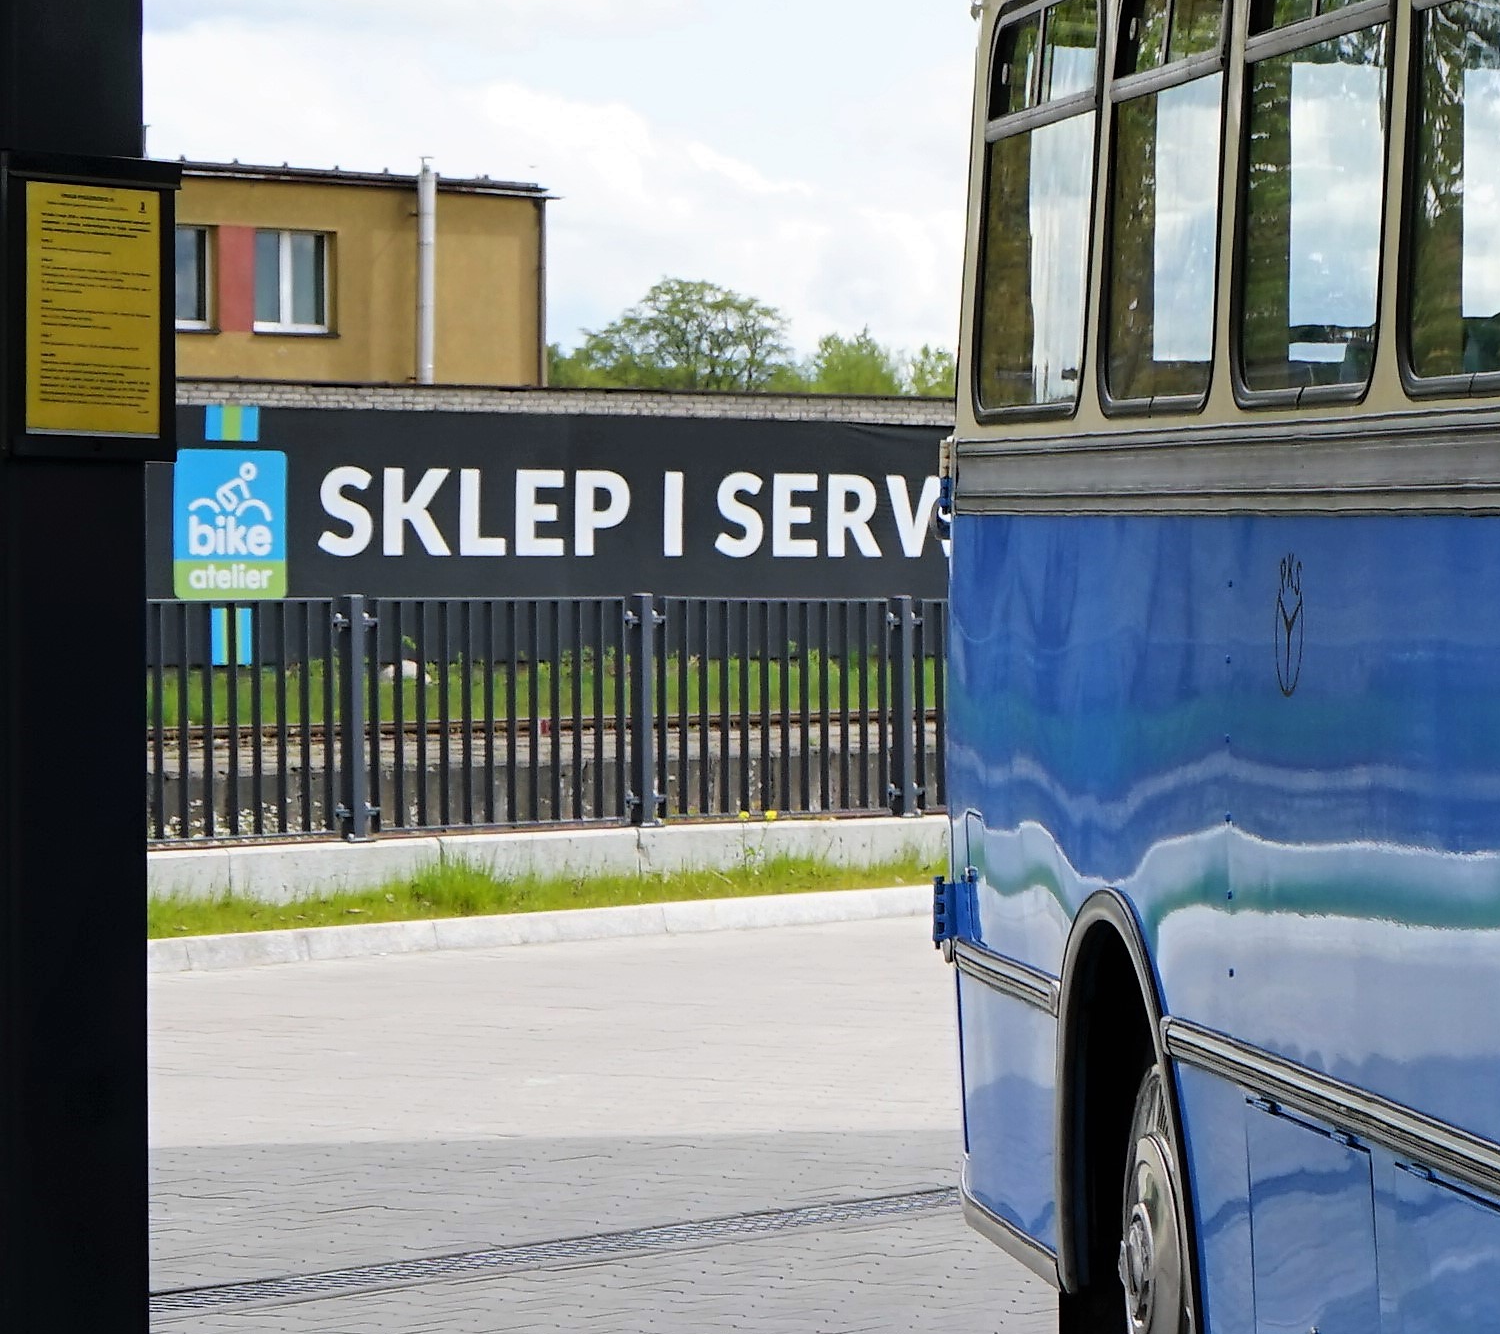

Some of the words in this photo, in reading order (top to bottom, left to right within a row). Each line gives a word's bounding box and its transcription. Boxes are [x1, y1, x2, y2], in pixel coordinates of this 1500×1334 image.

[317, 466, 632, 558] SKLEP
[663, 470, 685, 558] I
[188, 514, 274, 557] bike
[188, 564, 274, 590] atelier
